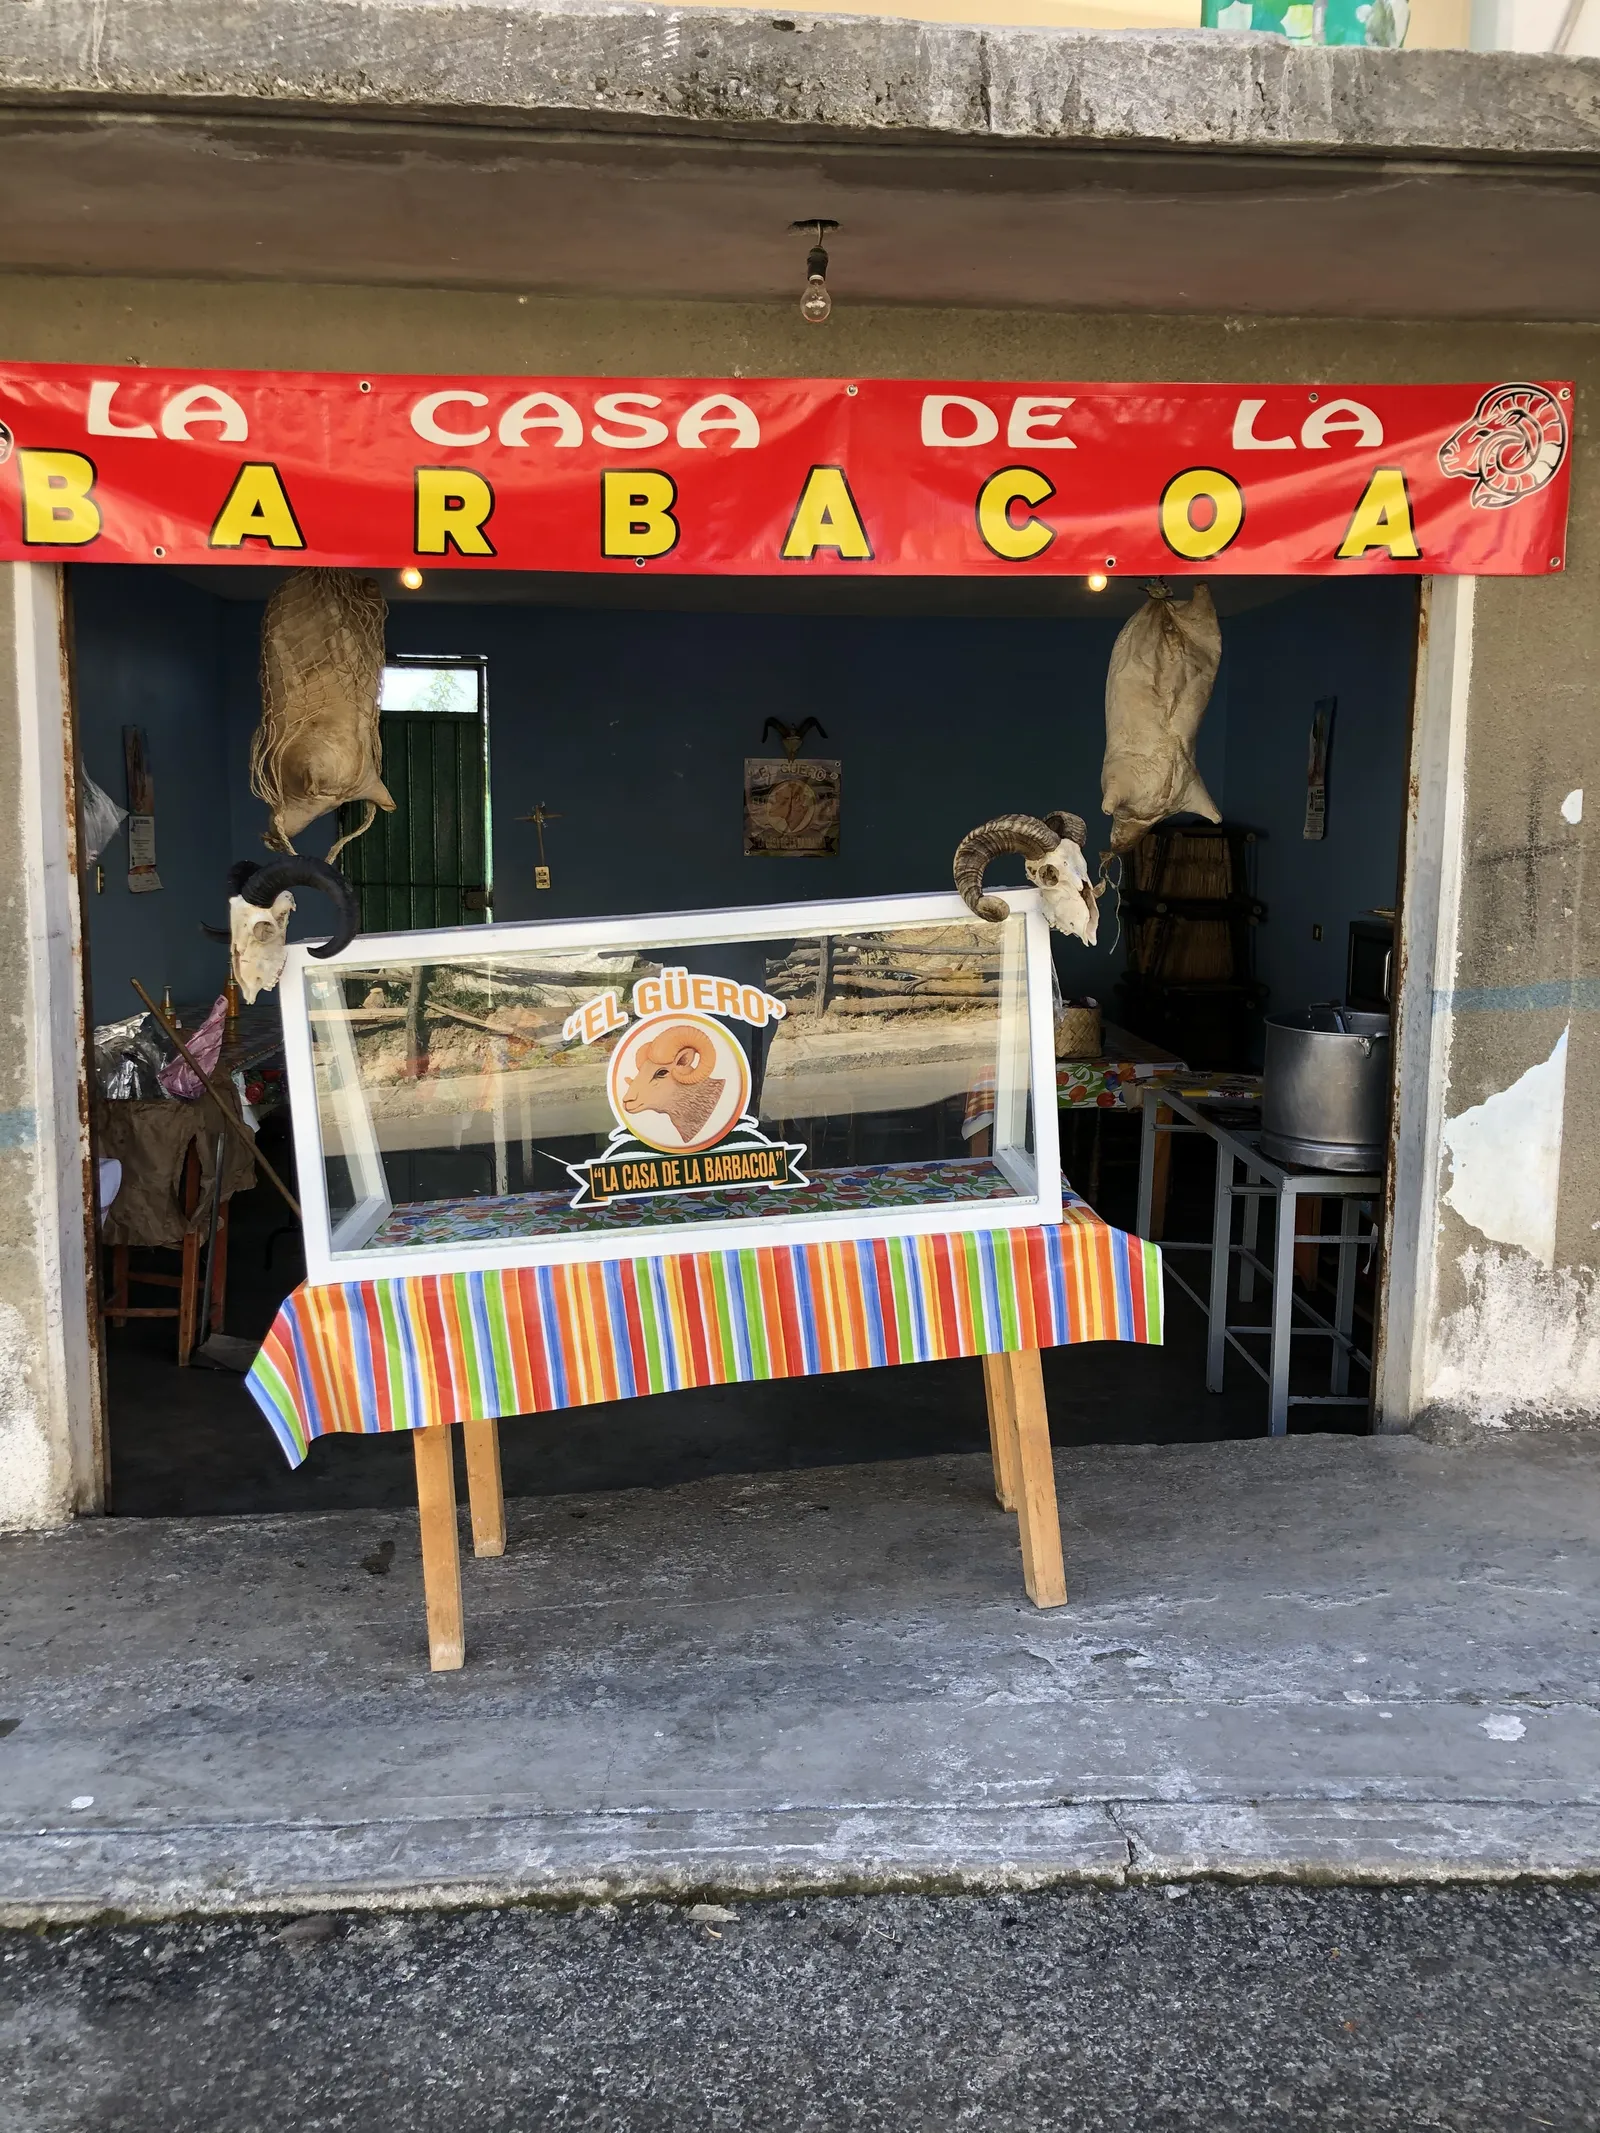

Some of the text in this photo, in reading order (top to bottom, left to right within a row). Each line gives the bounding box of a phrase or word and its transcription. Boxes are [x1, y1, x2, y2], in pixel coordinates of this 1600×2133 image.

[87, 381, 1384, 450] LA CASA DE LA
[17, 448, 1423, 560] BARBACOA
[621, 1161, 658, 1190] CASA
[662, 1160, 681, 1186] DE
[683, 1158, 702, 1184] LA
